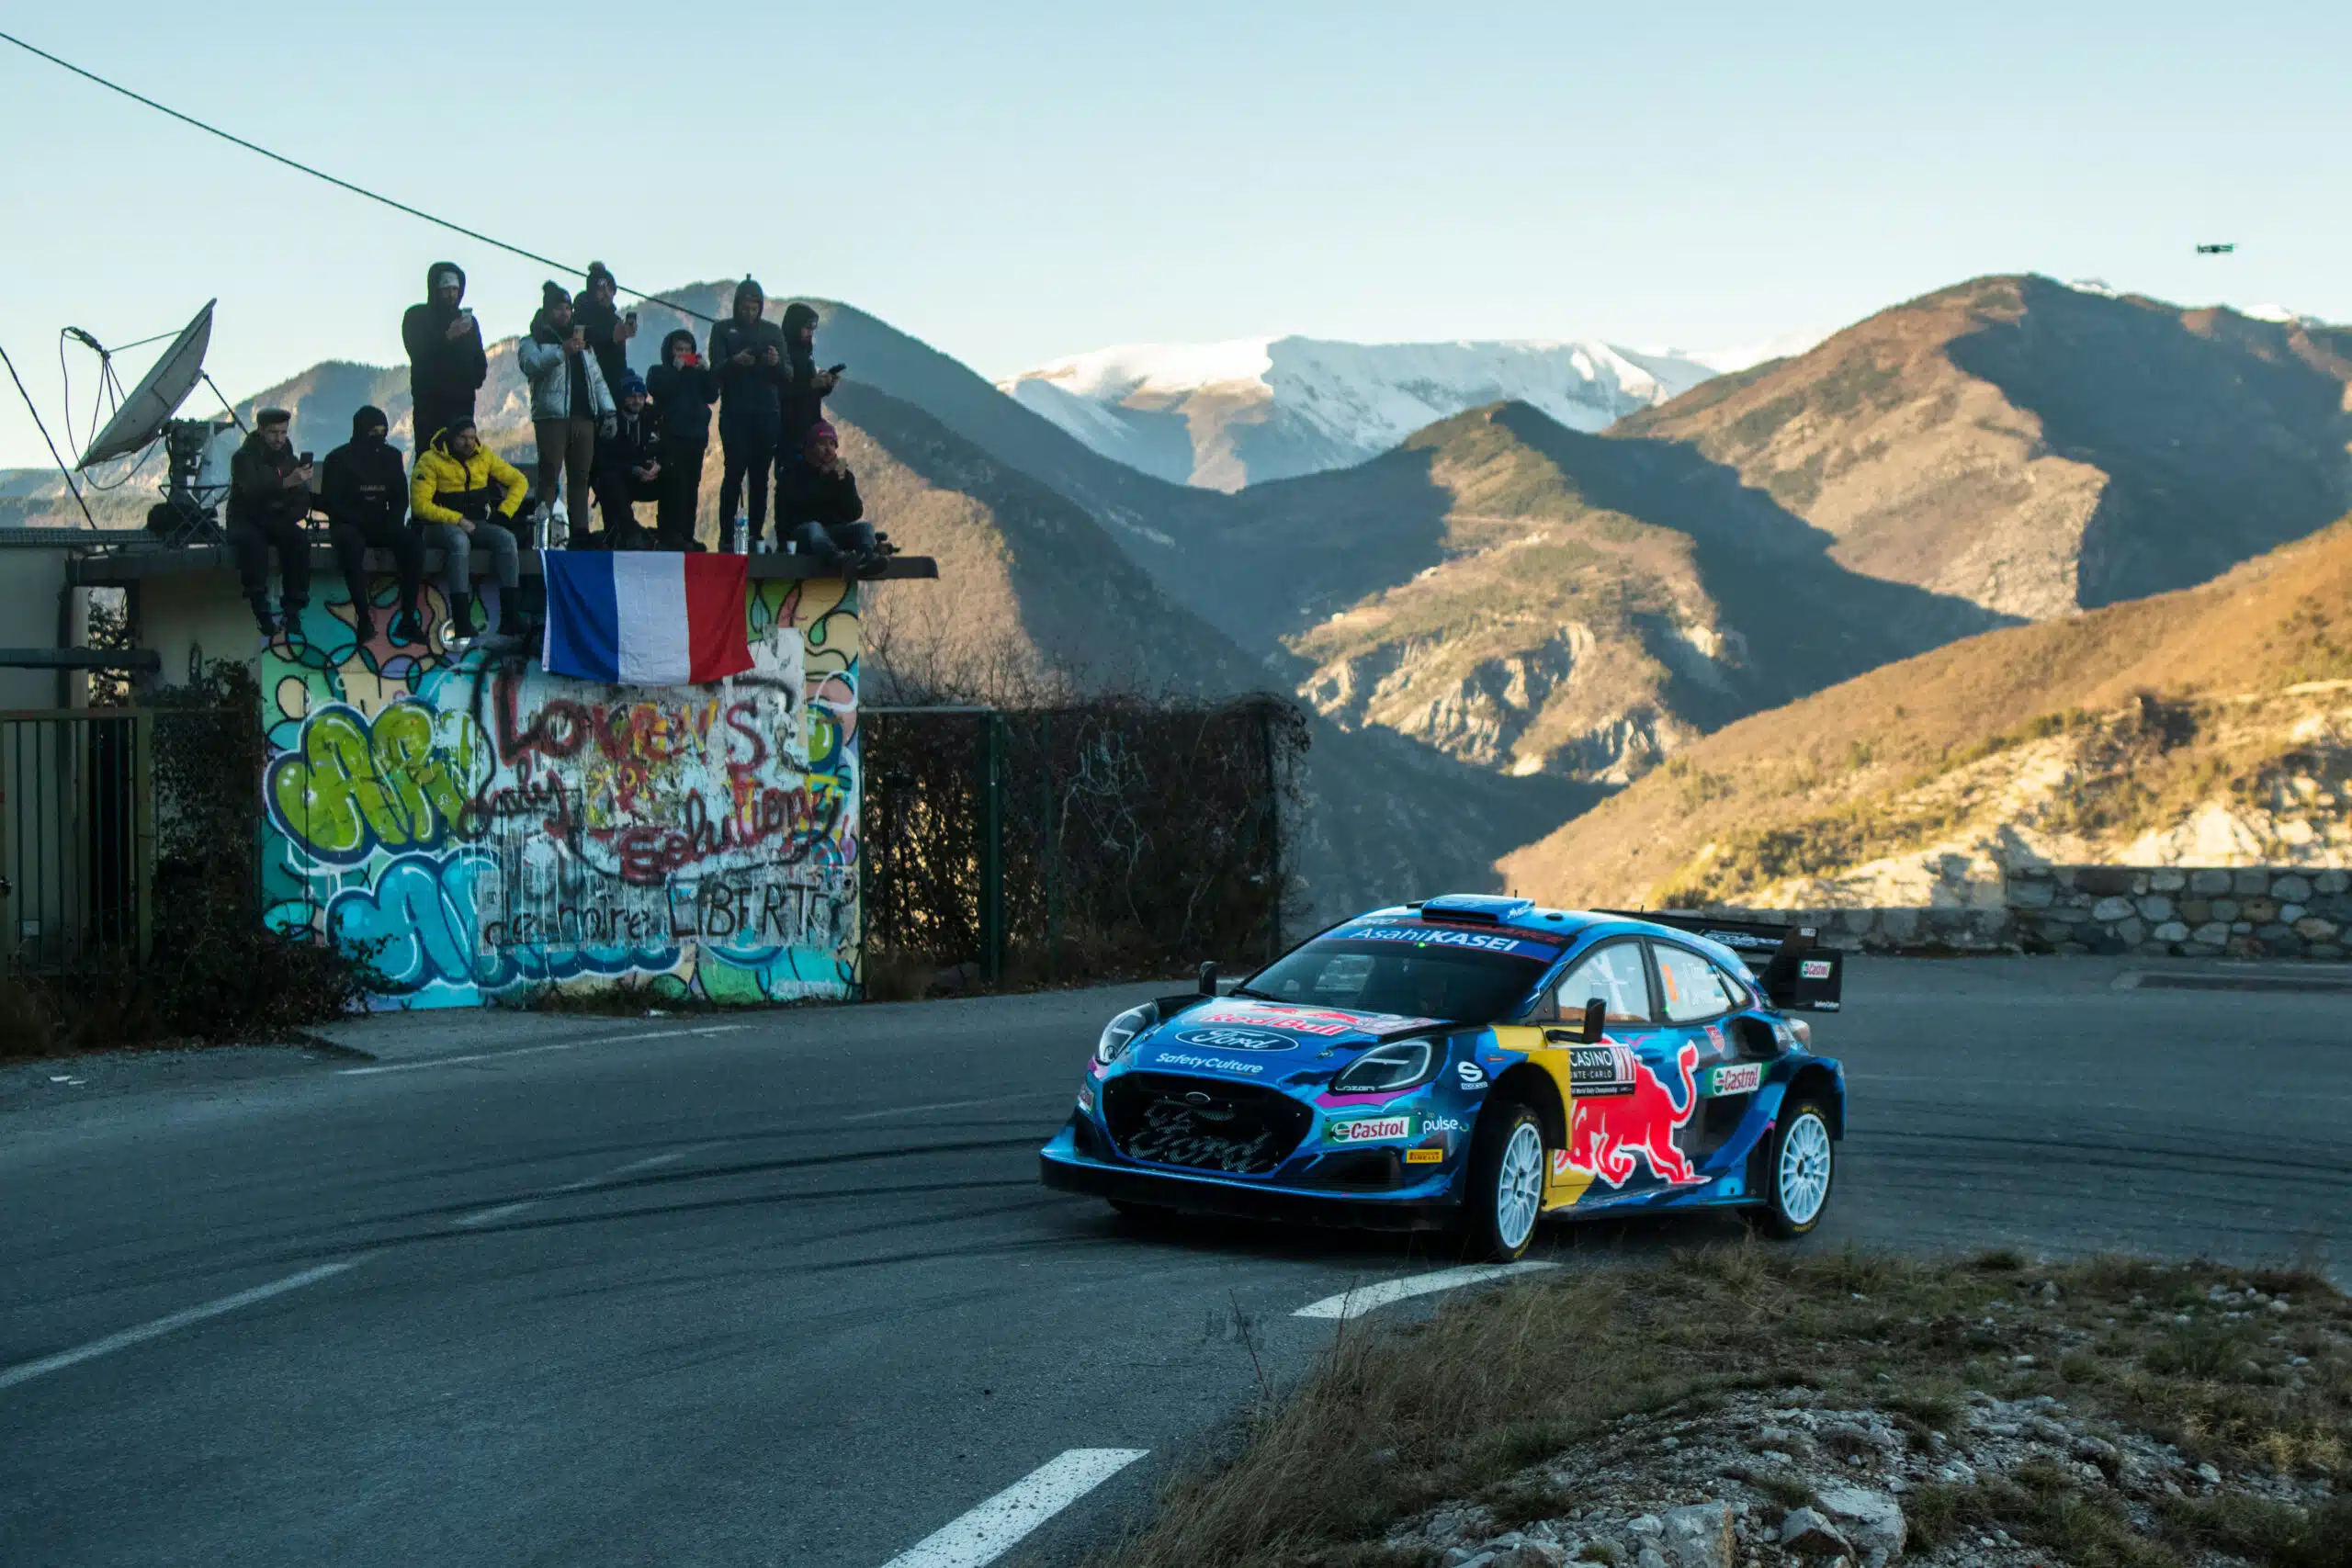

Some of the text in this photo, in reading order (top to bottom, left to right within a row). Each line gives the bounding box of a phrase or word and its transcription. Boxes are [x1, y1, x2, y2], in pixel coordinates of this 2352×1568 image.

[1202, 1013, 1273, 1025] Red
[1274, 1016, 1351, 1036] Bull
[1191, 1029, 1278, 1049] Ford
[1155, 1053, 1264, 1073] SafetyCulture
[1569, 1050, 1613, 1067] CASINO
[1724, 1066, 1759, 1091] Castrol
[1351, 1118, 1405, 1139] Castrol
[1422, 1116, 1459, 1134] pulse
